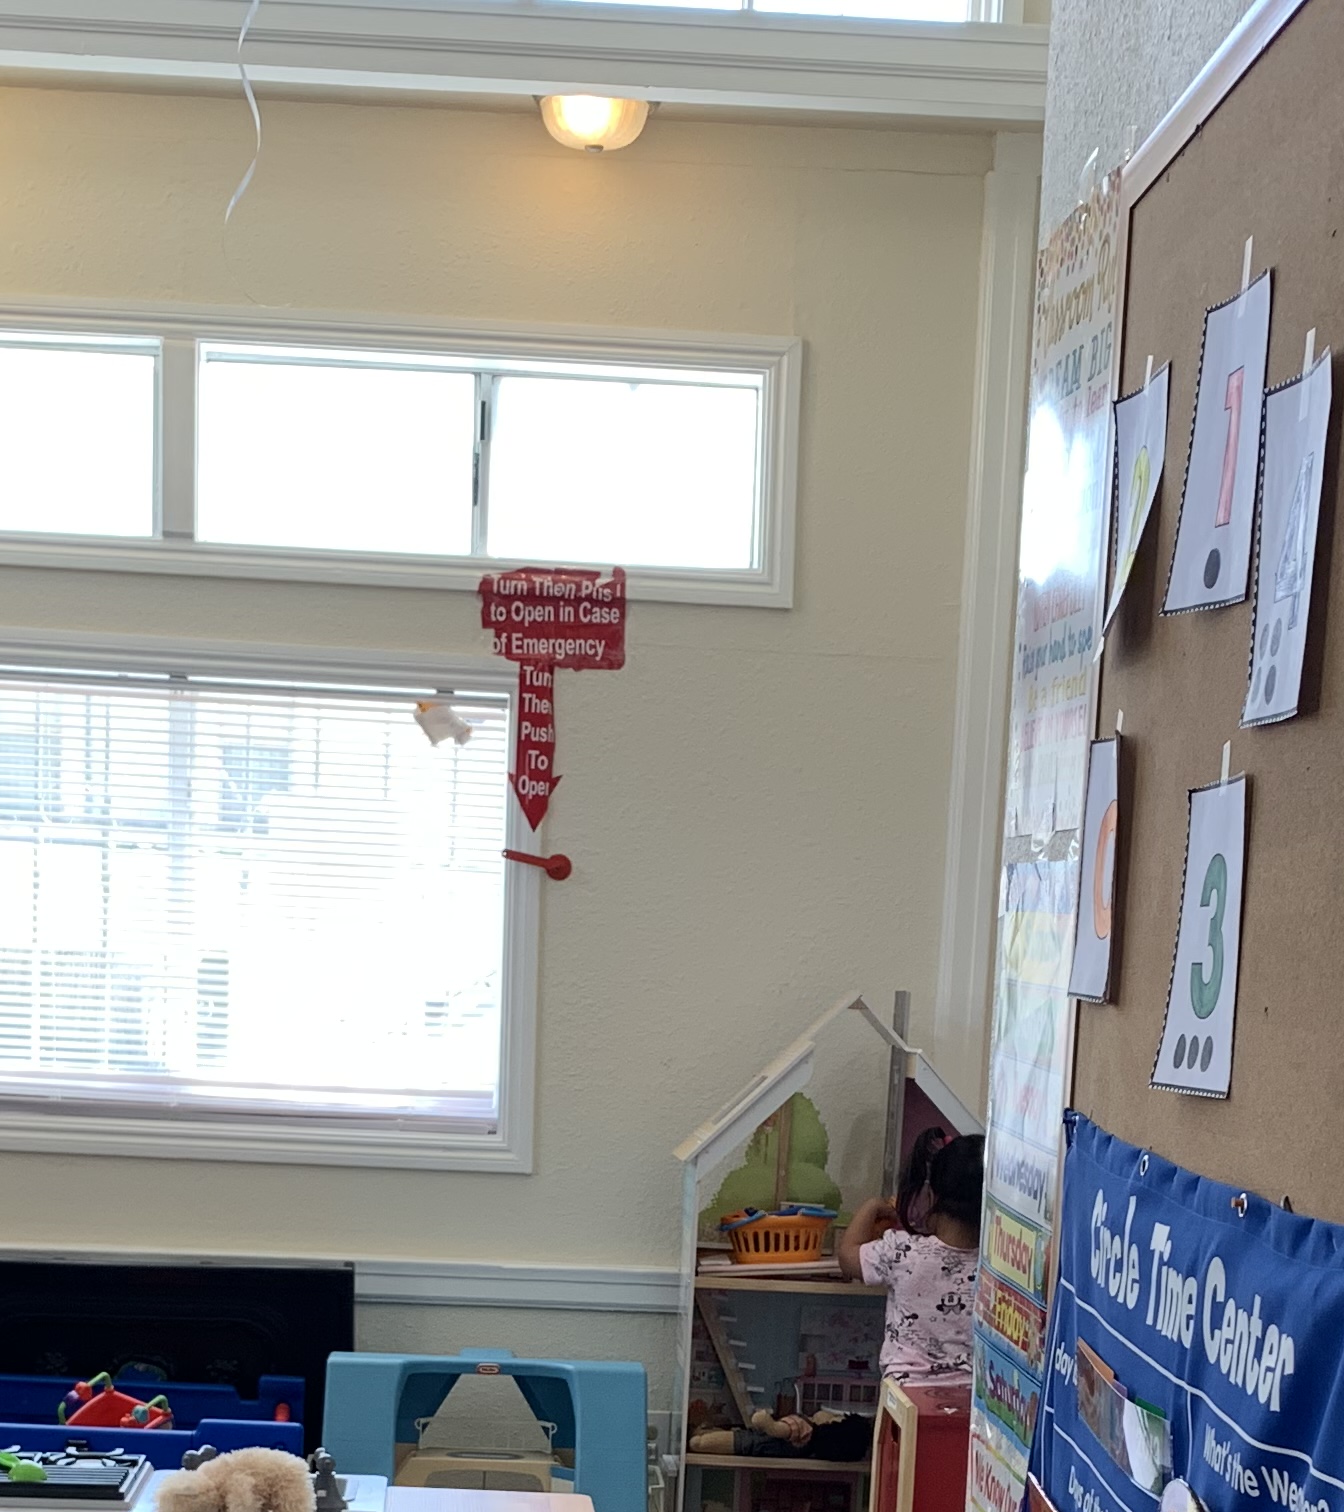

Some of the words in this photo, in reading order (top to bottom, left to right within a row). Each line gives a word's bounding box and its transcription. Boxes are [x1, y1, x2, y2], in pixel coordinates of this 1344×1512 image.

[1214, 364, 1246, 529] 1
[1273, 450, 1315, 631] 4
[490, 602, 506, 623] to
[511, 601, 554, 627] Open
[560, 601, 574, 623] in
[579, 601, 620, 625] Case
[492, 633, 507, 655] of
[511, 631, 606, 662] Emergency
[528, 749, 549, 771] To
[1190, 852, 1228, 1020] 3
[994, 1213, 1034, 1289] Thursday
[994, 1288, 1026, 1348] Friday
[1089, 1187, 1141, 1311] Circle
[1145, 1221, 1198, 1351] Time
[1202, 1255, 1296, 1414] Center
